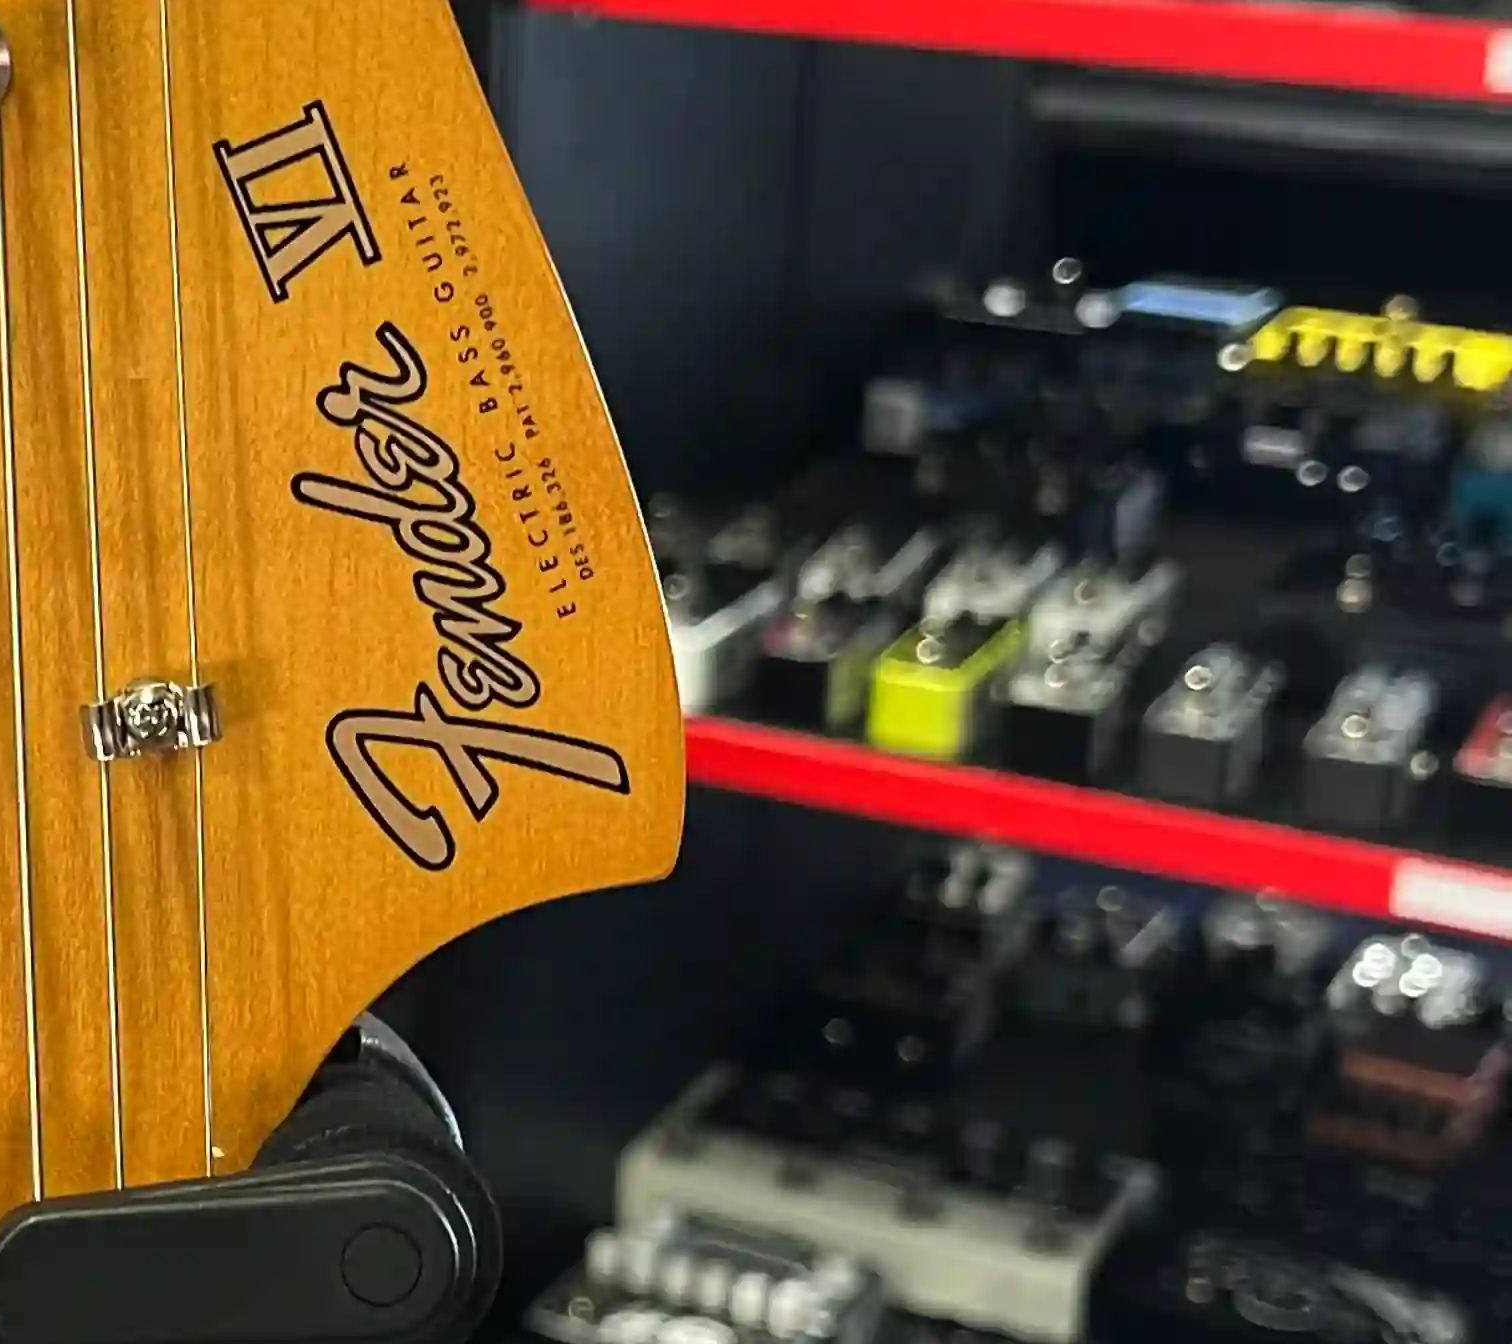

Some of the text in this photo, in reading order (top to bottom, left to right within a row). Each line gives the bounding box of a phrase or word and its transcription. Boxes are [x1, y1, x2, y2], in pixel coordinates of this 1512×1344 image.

[212, 99, 381, 306] VI
[389, 162, 576, 619] ELECTRIC BASS GUITAR
[517, 405, 540, 439] PAT
[290, 320, 631, 872] Fender
[569, 543, 594, 580] DES
